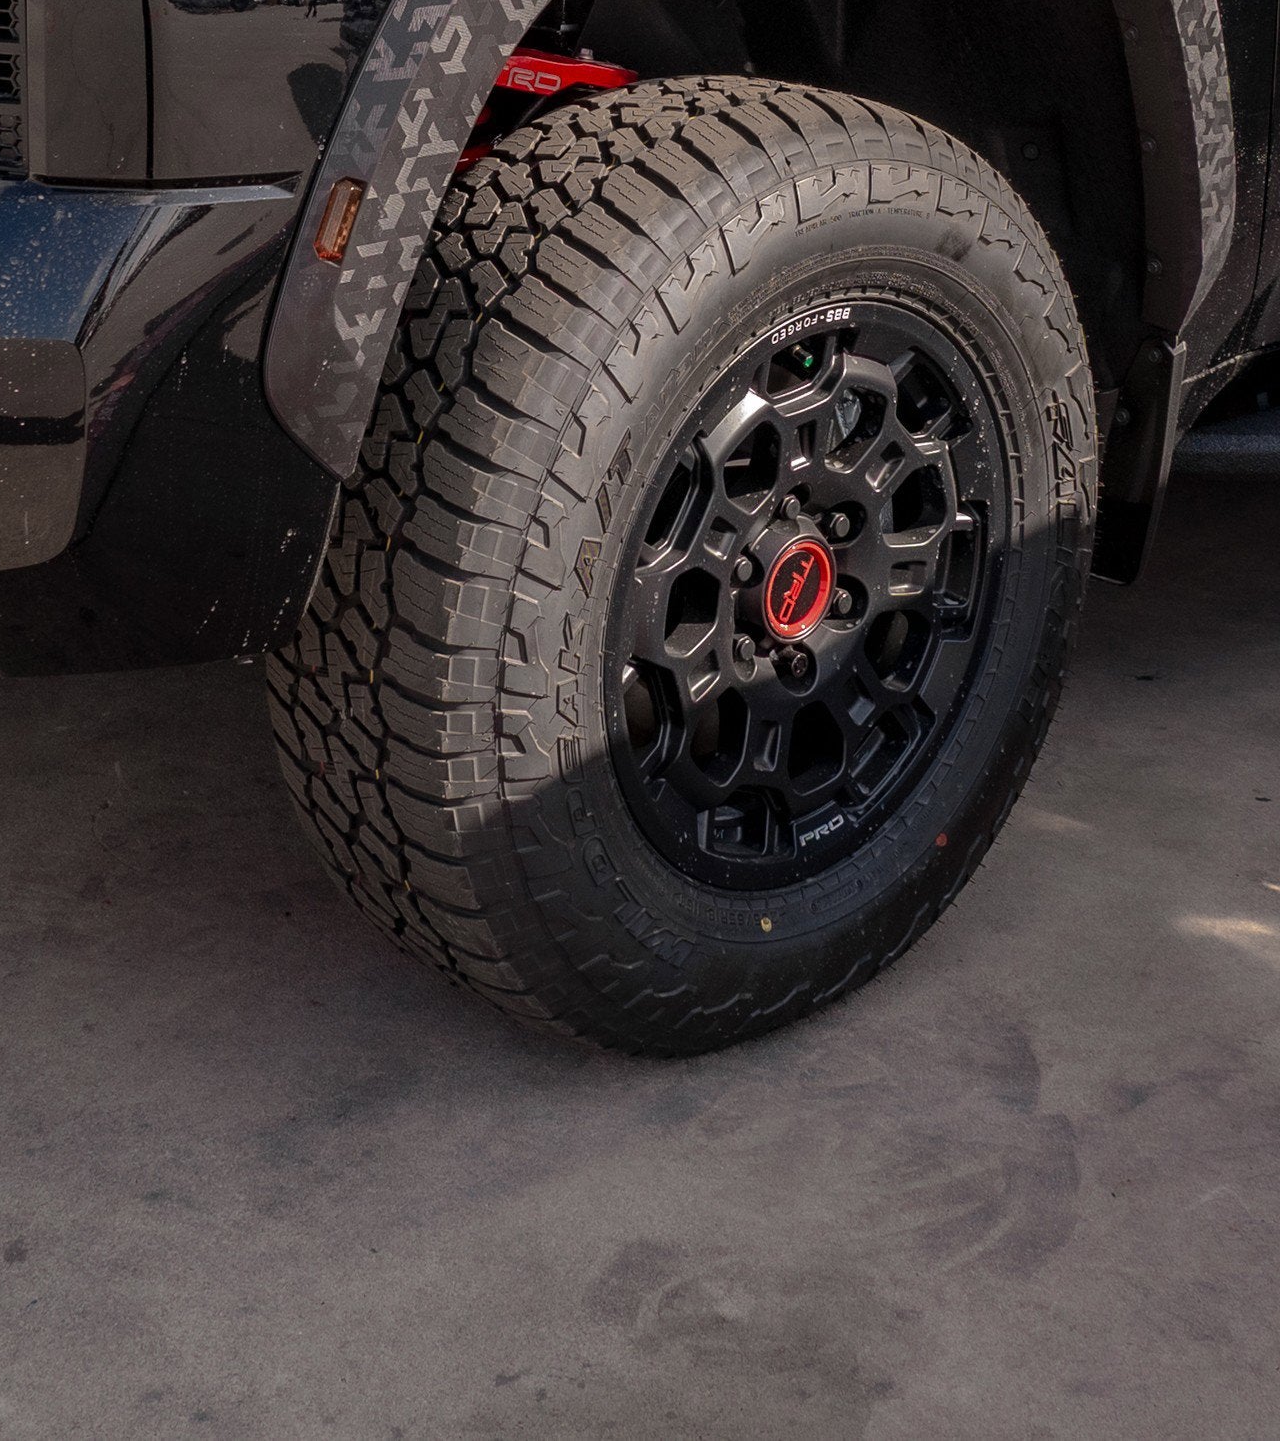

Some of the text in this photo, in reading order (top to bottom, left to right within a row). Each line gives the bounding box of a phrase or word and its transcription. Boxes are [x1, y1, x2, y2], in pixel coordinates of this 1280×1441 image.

[503, 65, 561, 92] RD
[779, 555, 815, 624] TRD
[799, 814, 844, 847] PRO
